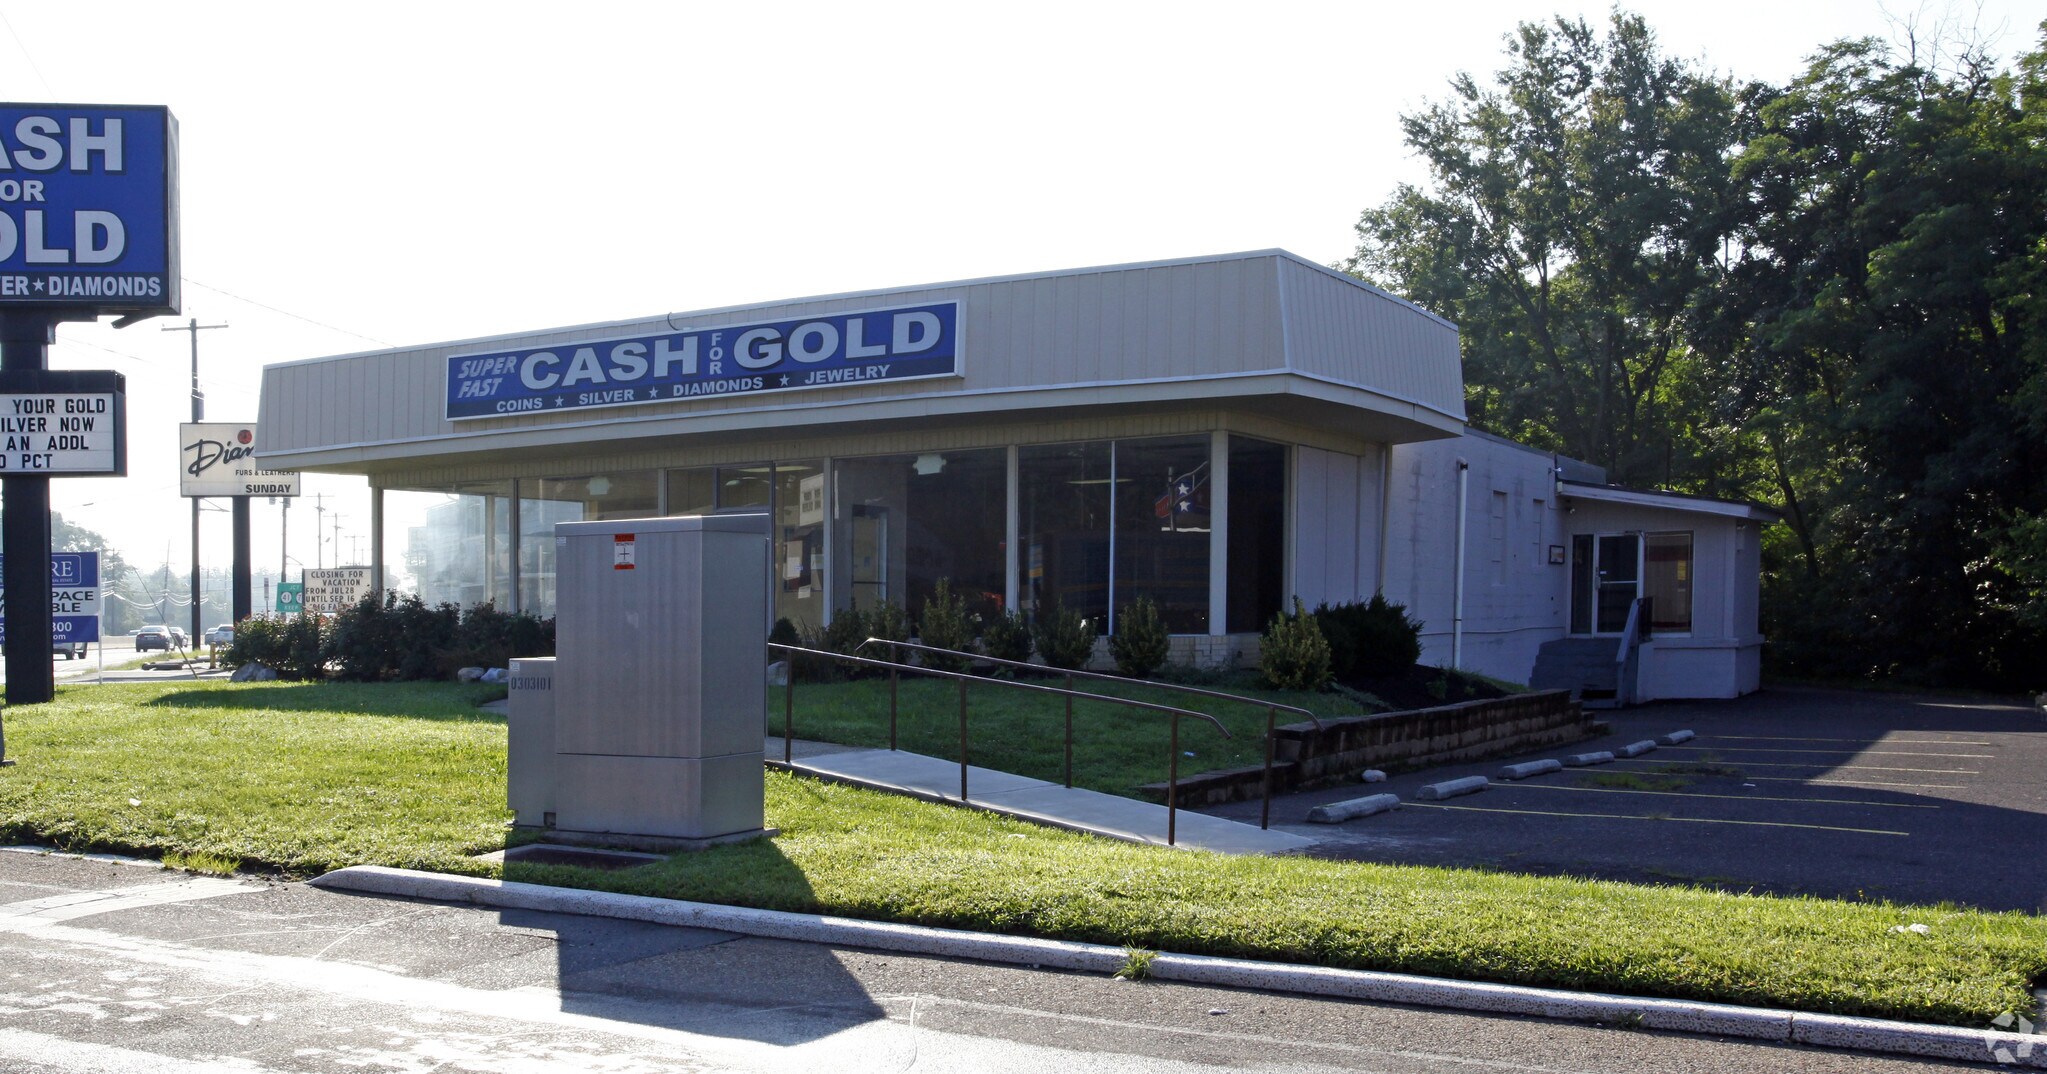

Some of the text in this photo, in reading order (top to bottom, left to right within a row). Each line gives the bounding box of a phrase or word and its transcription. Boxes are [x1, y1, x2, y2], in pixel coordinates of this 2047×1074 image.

[0, 116, 123, 171] SH
[0, 179, 46, 202] OR
[48, 276, 161, 297] DIAMONDS
[519, 311, 942, 391] CASH FOR GOLD
[457, 356, 518, 379] SUPER
[457, 377, 503, 399] FAST
[496, 364, 891, 413] COINS SILVER DIAMONDS JEWELRY
[13, 398, 106, 414] YOUR GOLD
[0, 416, 95, 432] ILVER NOW
[6, 435, 89, 451] AN ADDL
[21, 453, 53, 468] PCT
[246, 484, 292, 493] SUNDAY
[52, 561, 73, 577] RE
[52, 591, 94, 601] PACE
[305, 587, 327, 595] FROM
[305, 595, 328, 603] UNTIL
[52, 603, 81, 613] BLE
